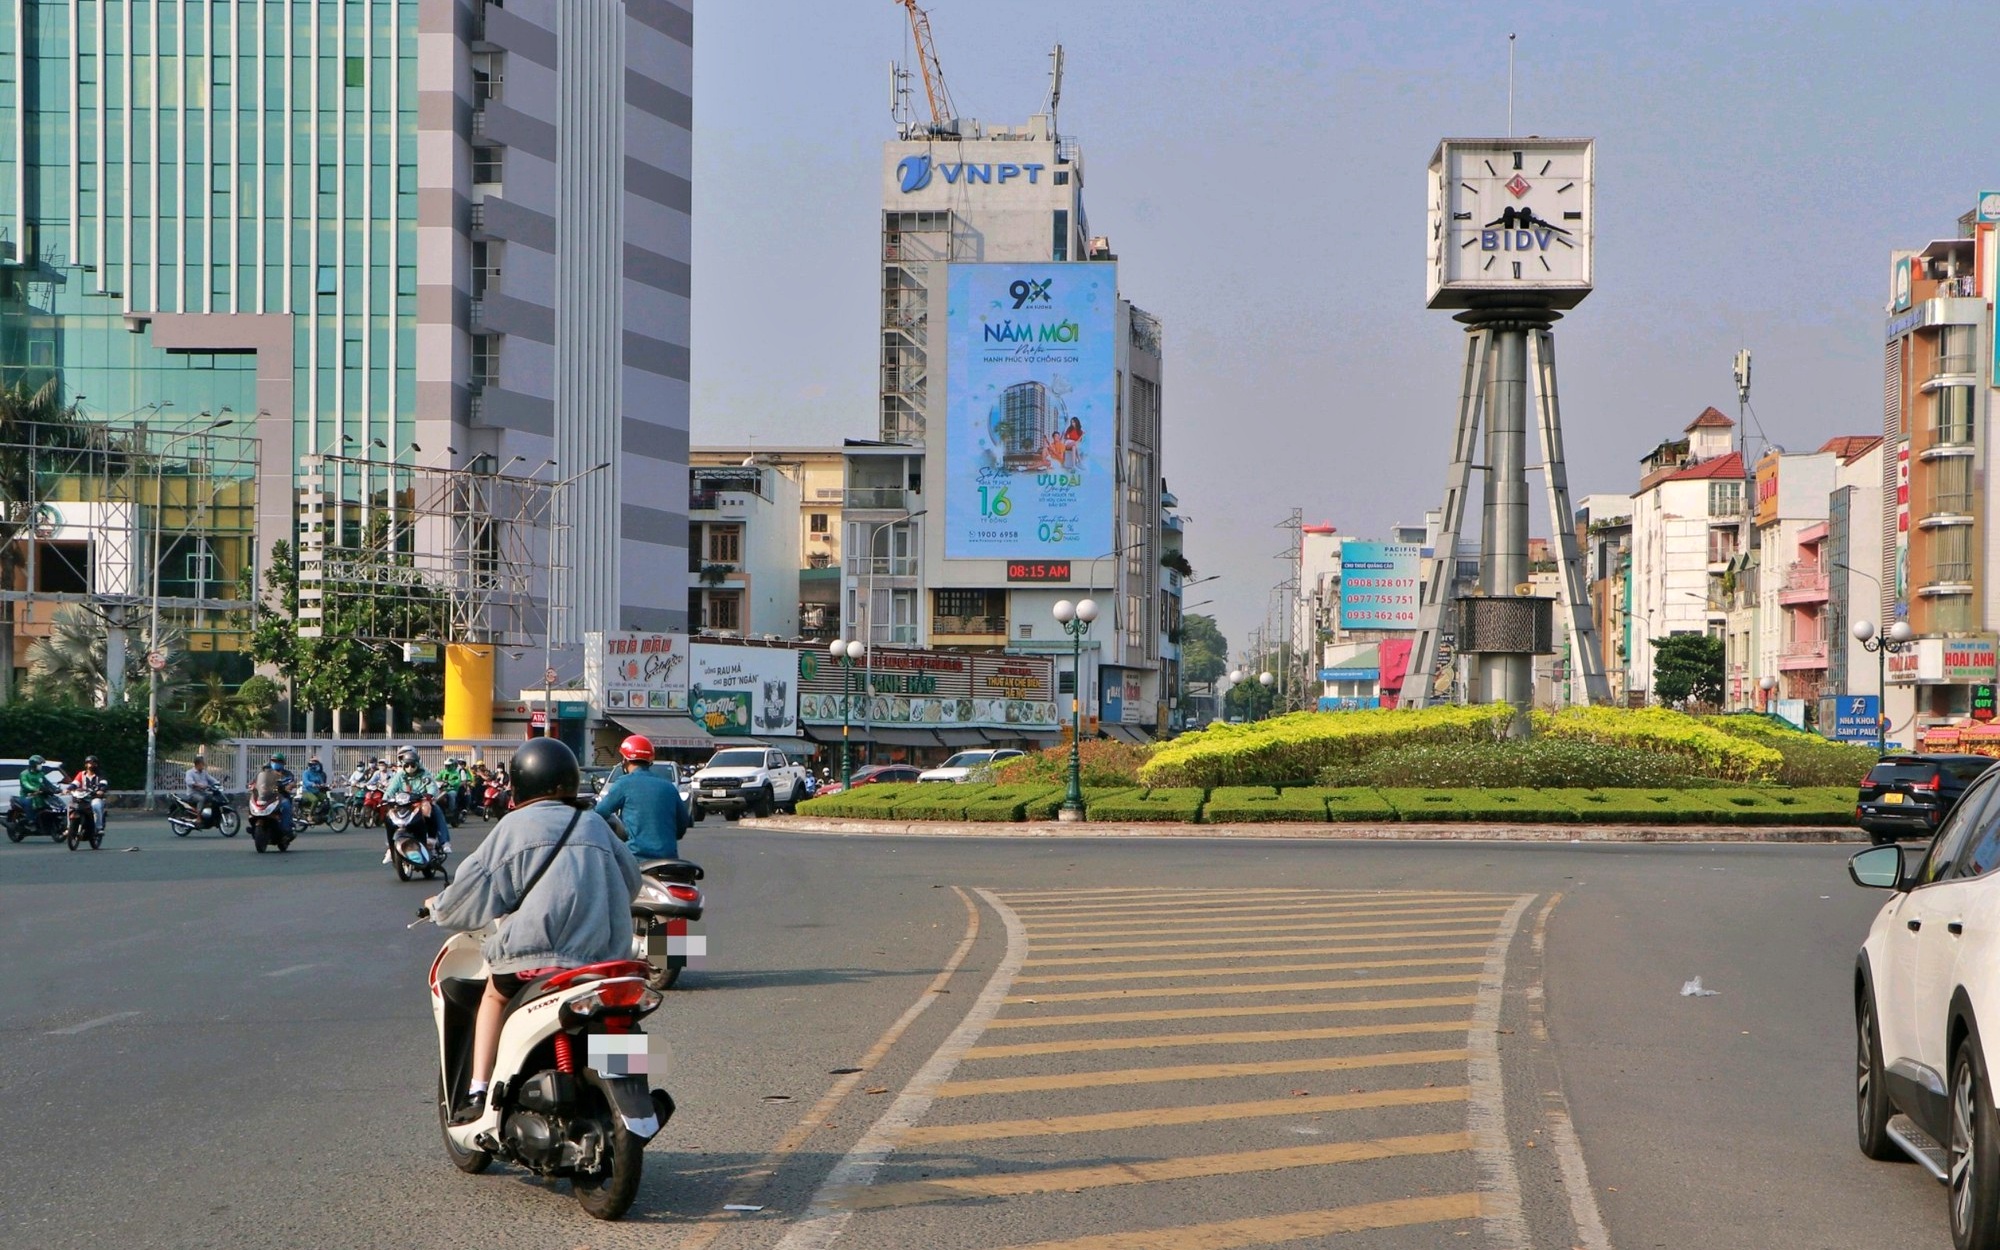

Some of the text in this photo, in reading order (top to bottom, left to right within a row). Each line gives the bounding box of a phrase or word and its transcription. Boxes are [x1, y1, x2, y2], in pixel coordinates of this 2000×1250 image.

[939, 163, 1044, 184] VNPT
[1482, 230, 1552, 251] BIDV
[984, 318, 1079, 343] NĂM MỚI
[1009, 565, 1068, 577] 08:15 AM
[1347, 578, 1414, 587] 0908 328 017
[1347, 594, 1413, 604] 0977 755 751
[1347, 611, 1414, 620] 0933 462 404
[608, 634, 637, 655] TRÀ
[1973, 653, 1994, 666] ANH
[717, 665, 731, 675] RAU
[731, 662, 742, 673] MÁ
[1975, 699, 1992, 708] QUY
[1839, 717, 1875, 725] NHA KHOA
[1837, 727, 1857, 736] SAINT
[1859, 727, 1877, 736] PAUL
